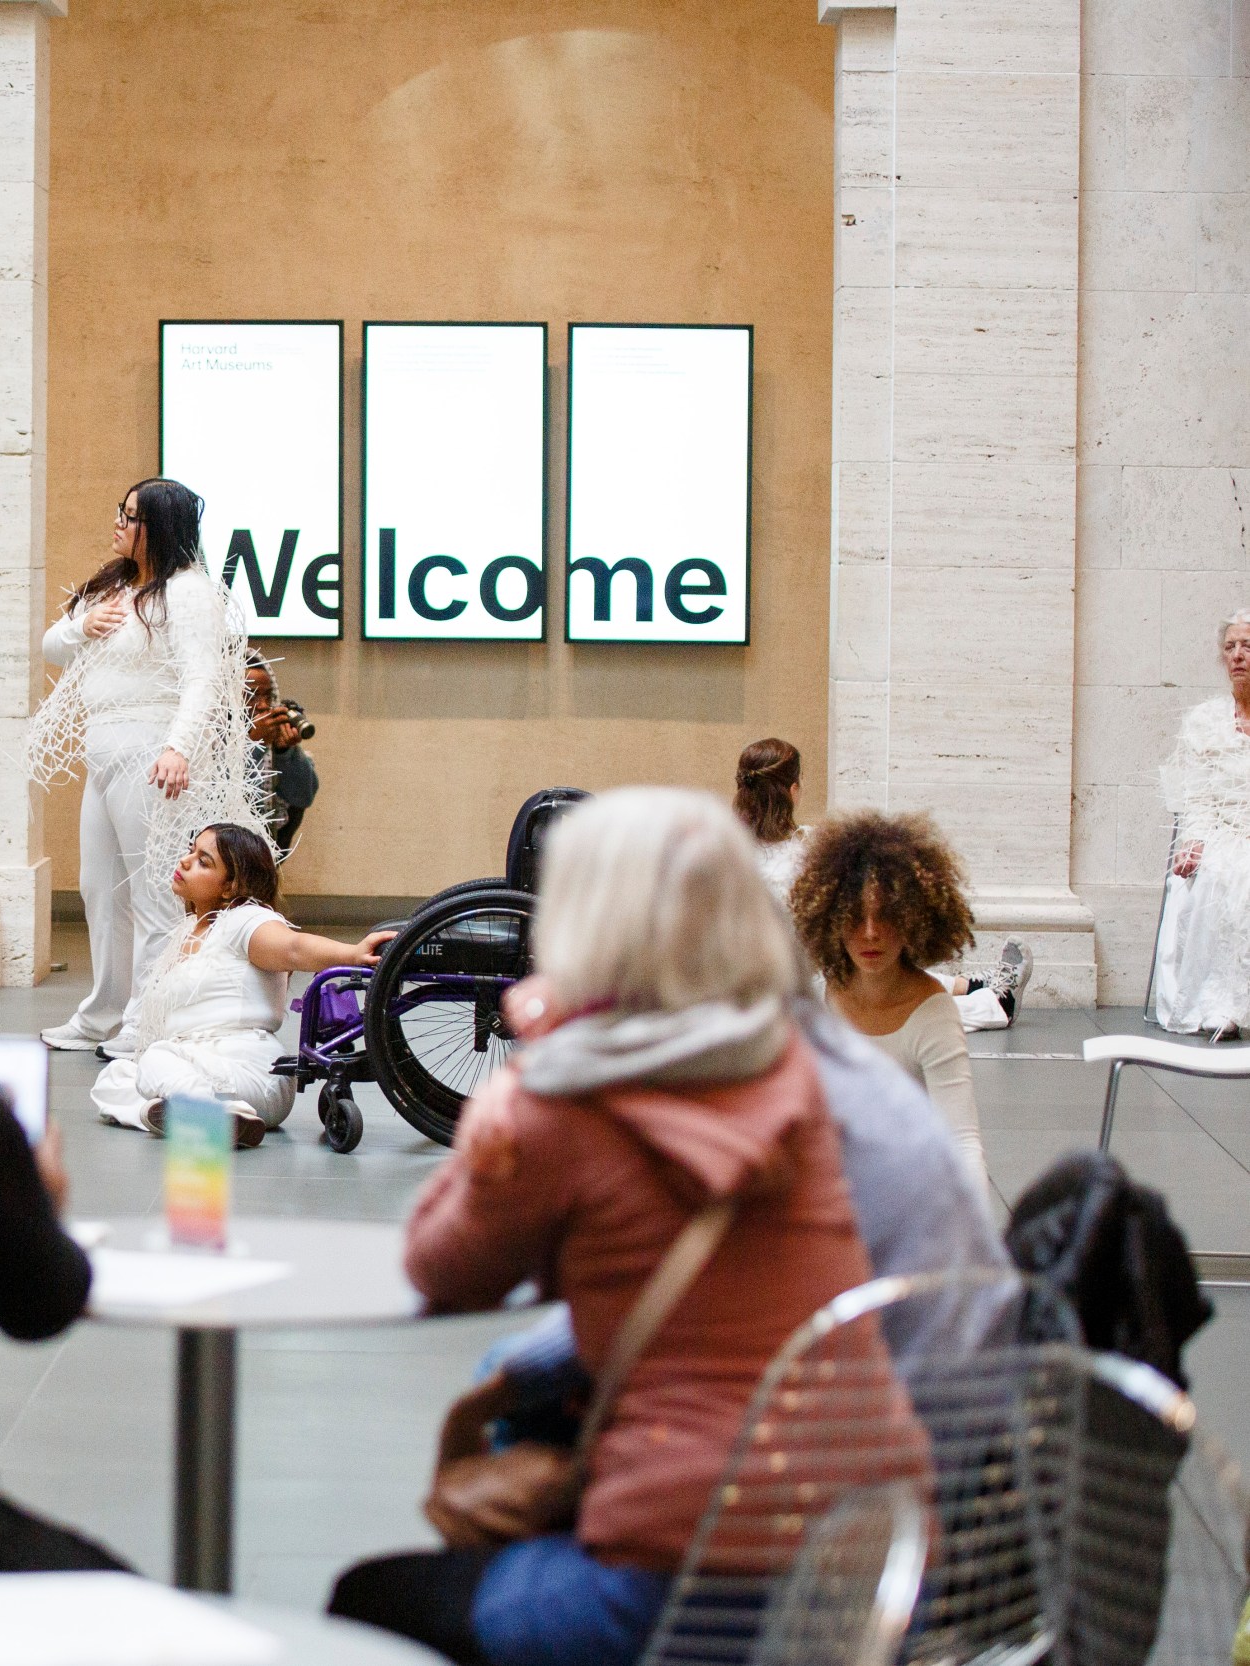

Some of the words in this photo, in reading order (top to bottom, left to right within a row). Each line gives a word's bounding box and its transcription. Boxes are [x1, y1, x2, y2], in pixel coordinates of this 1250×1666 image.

[180, 342, 238, 355] Harvard
[181, 358, 202, 371] Art
[205, 358, 274, 371] Museums
